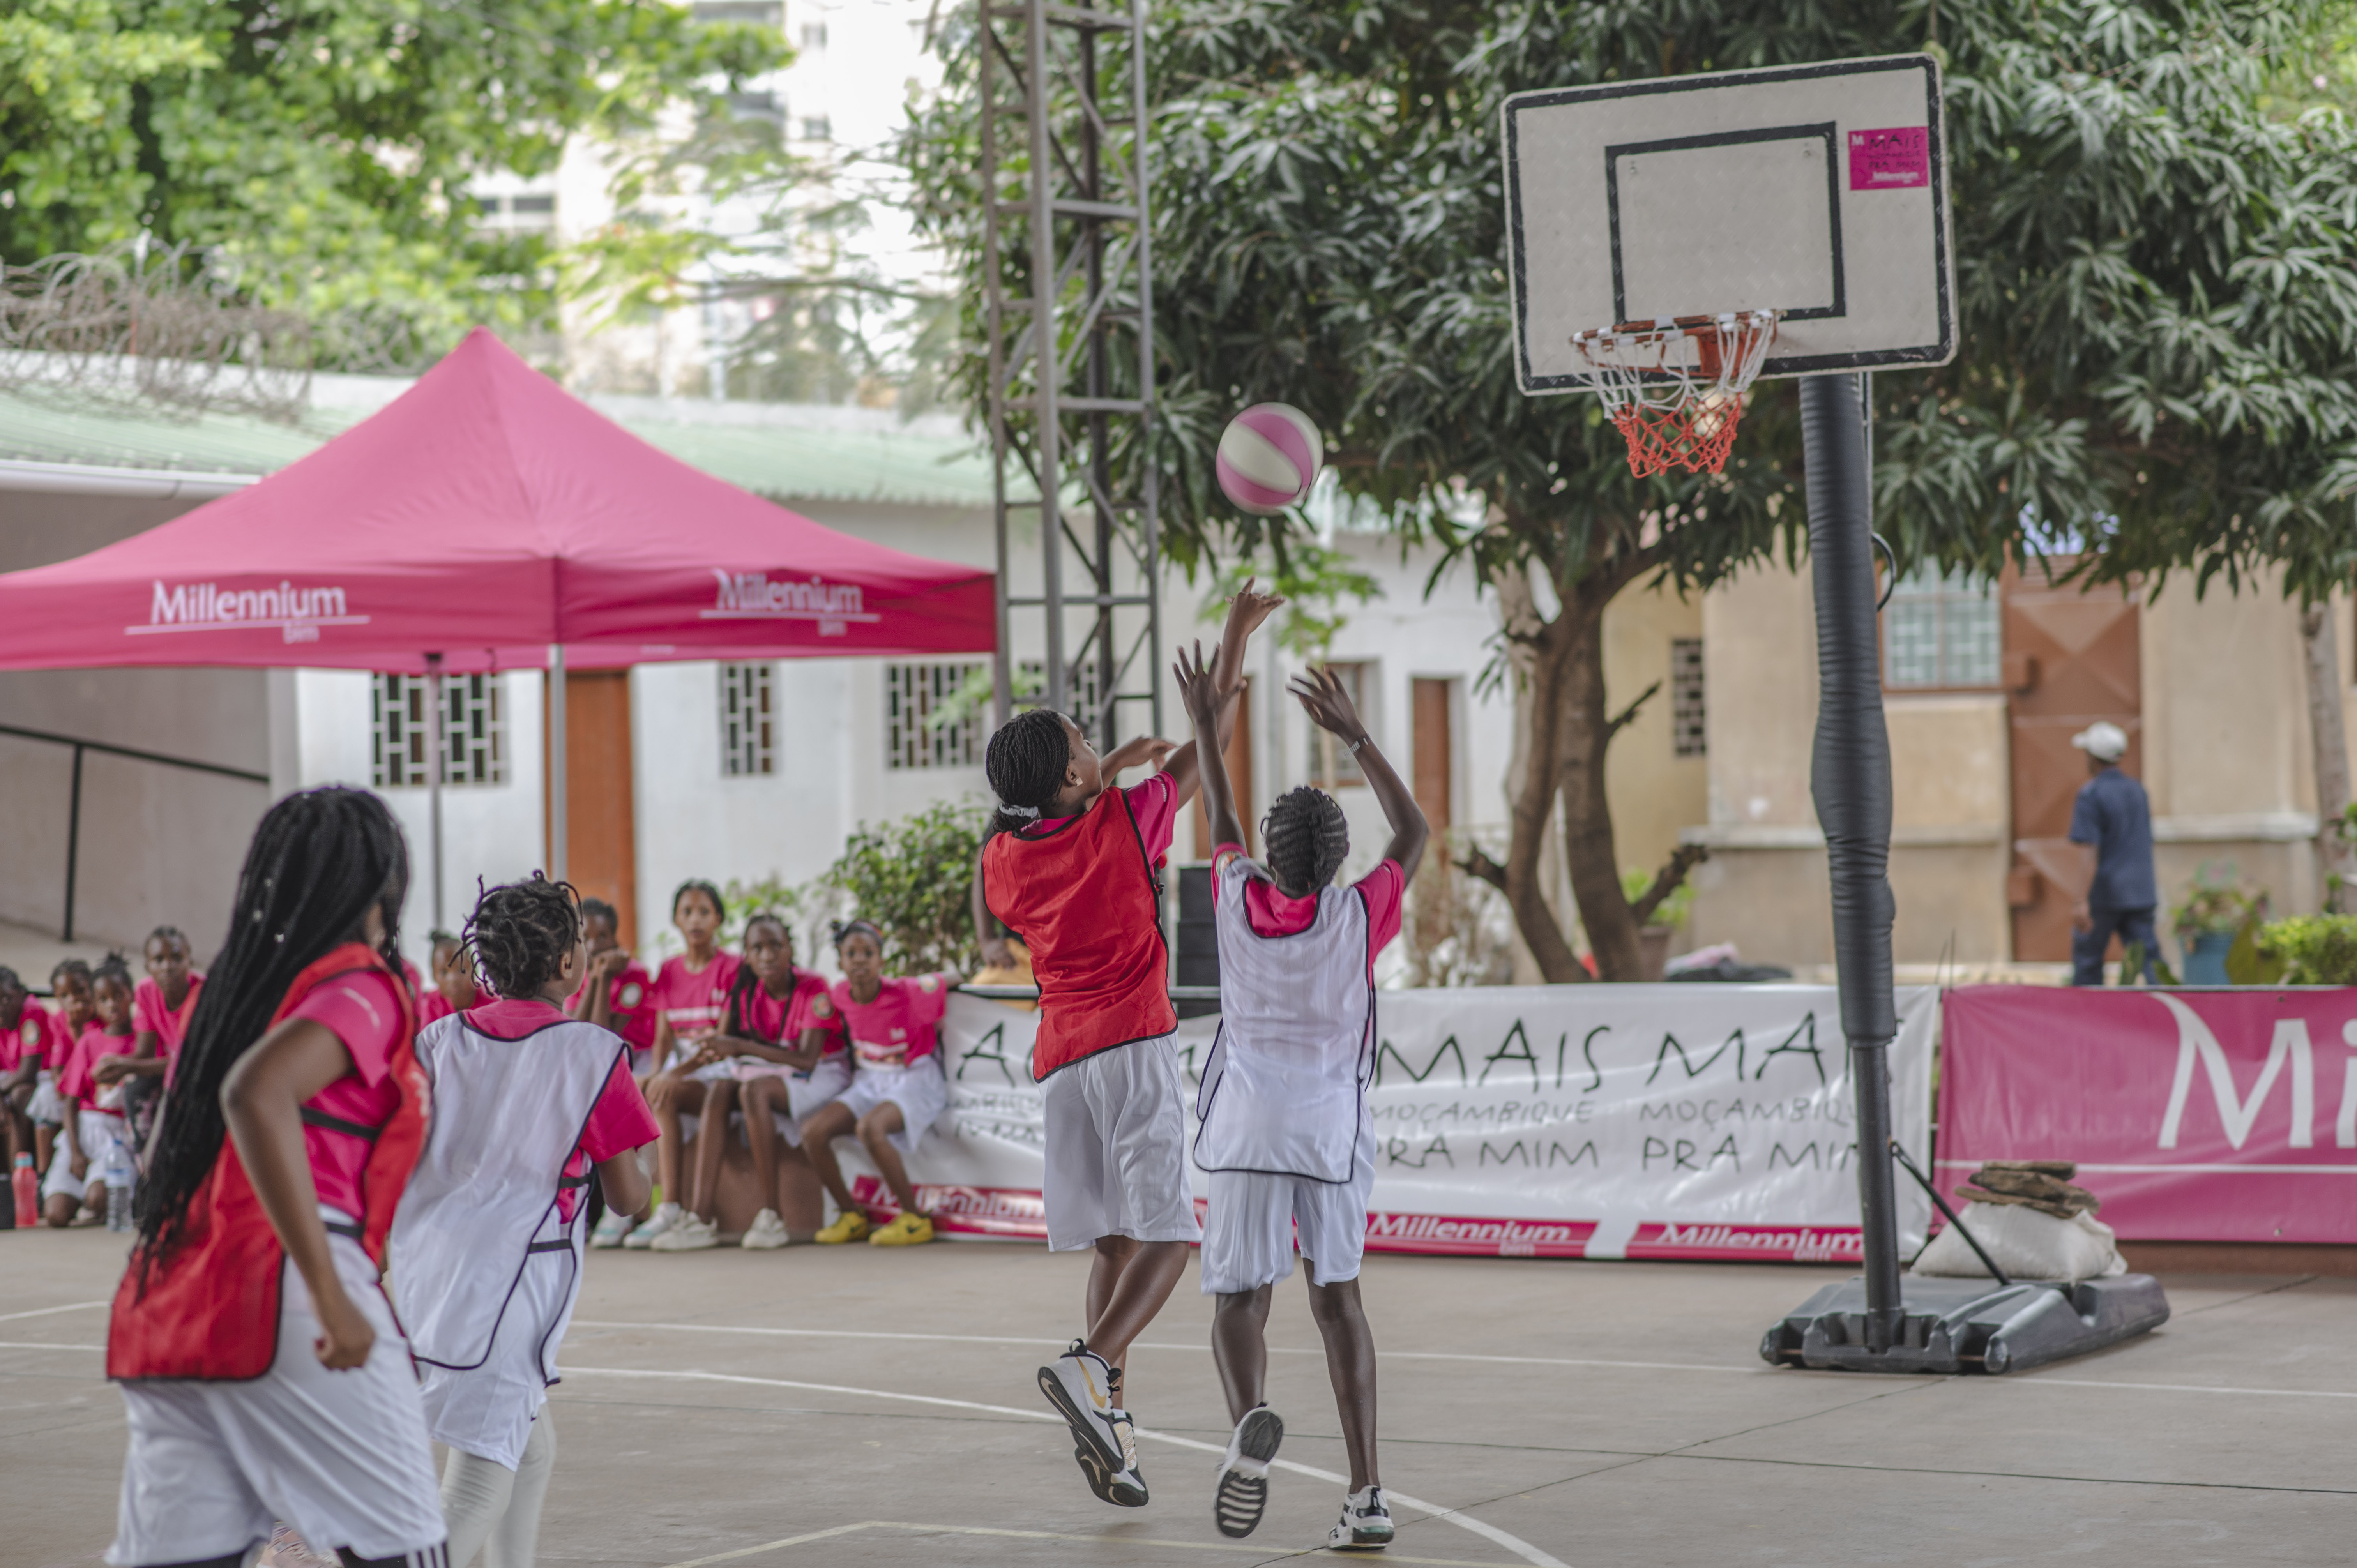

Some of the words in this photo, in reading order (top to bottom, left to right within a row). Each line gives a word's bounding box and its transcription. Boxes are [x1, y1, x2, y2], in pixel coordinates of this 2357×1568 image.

[150, 580, 347, 625] Millennium
[712, 567, 863, 613] Millennium
[1375, 1017, 1611, 1092] MAIS
[1480, 1139, 1600, 1169] MIM
[1642, 1133, 1741, 1171] PRA
[1366, 1211, 1571, 1242] Millennium
